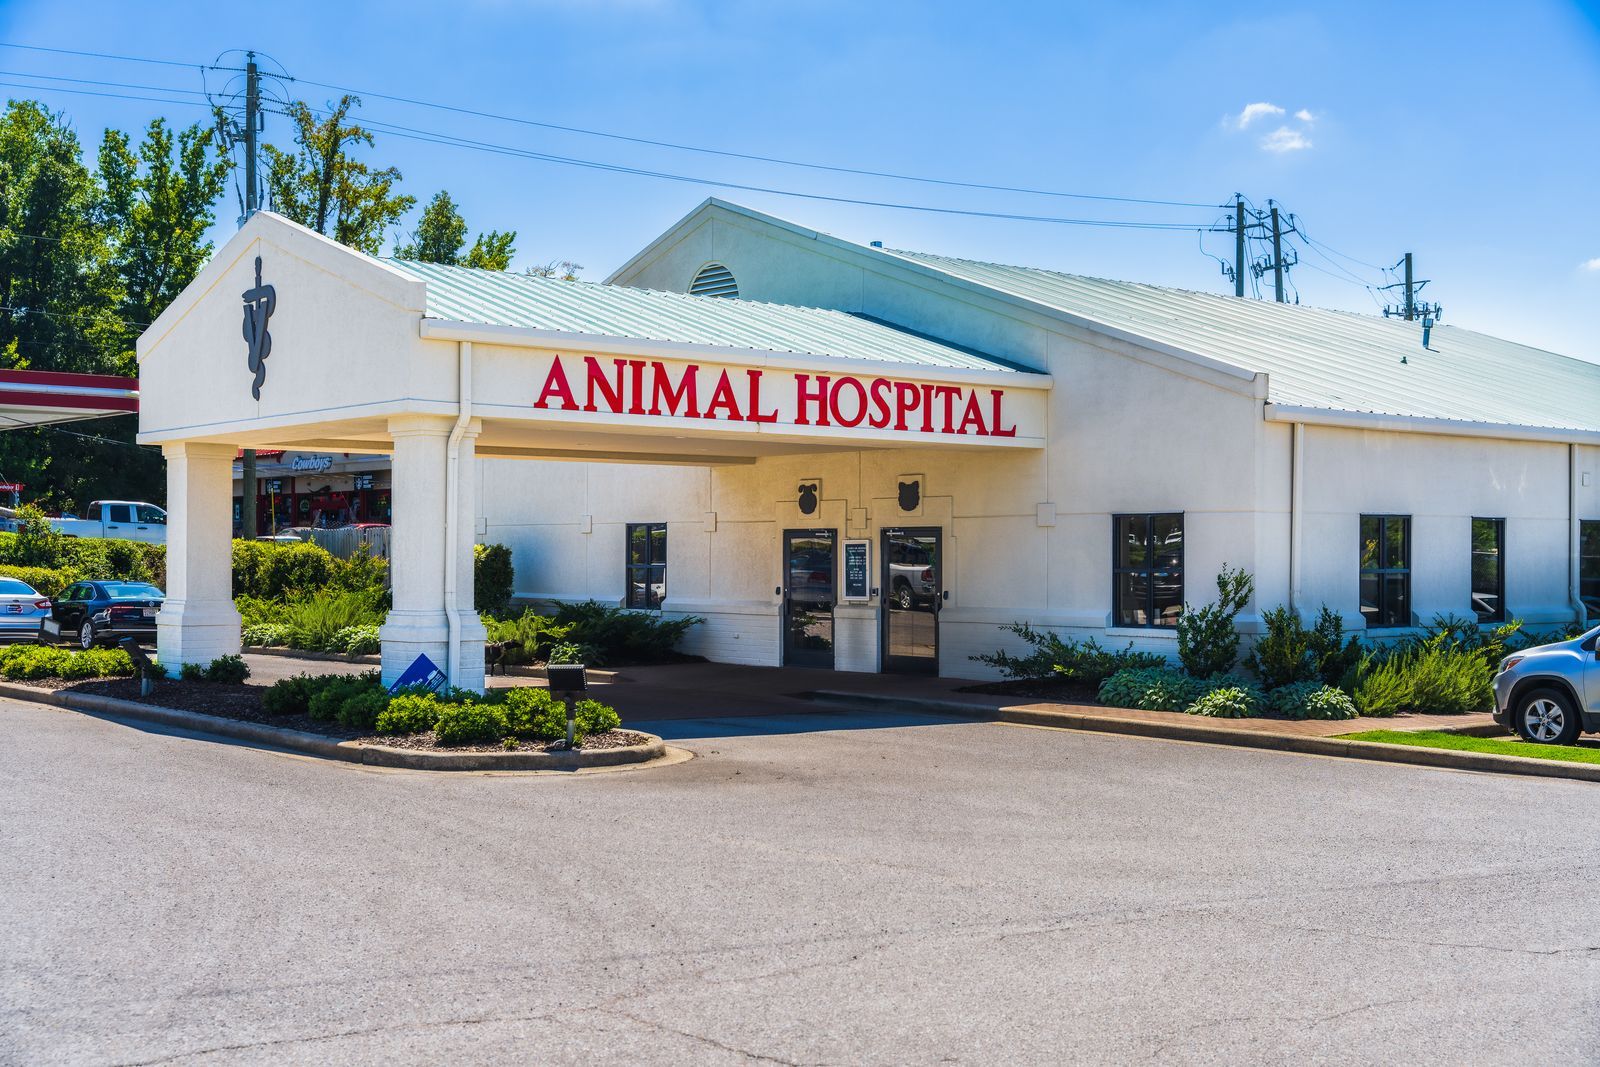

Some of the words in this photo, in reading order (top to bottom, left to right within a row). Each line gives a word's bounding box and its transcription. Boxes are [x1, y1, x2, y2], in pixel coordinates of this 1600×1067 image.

[533, 354, 779, 423] ANIMAL
[794, 373, 1017, 437] HOSPITAL
[291, 455, 333, 472] Cowboys
